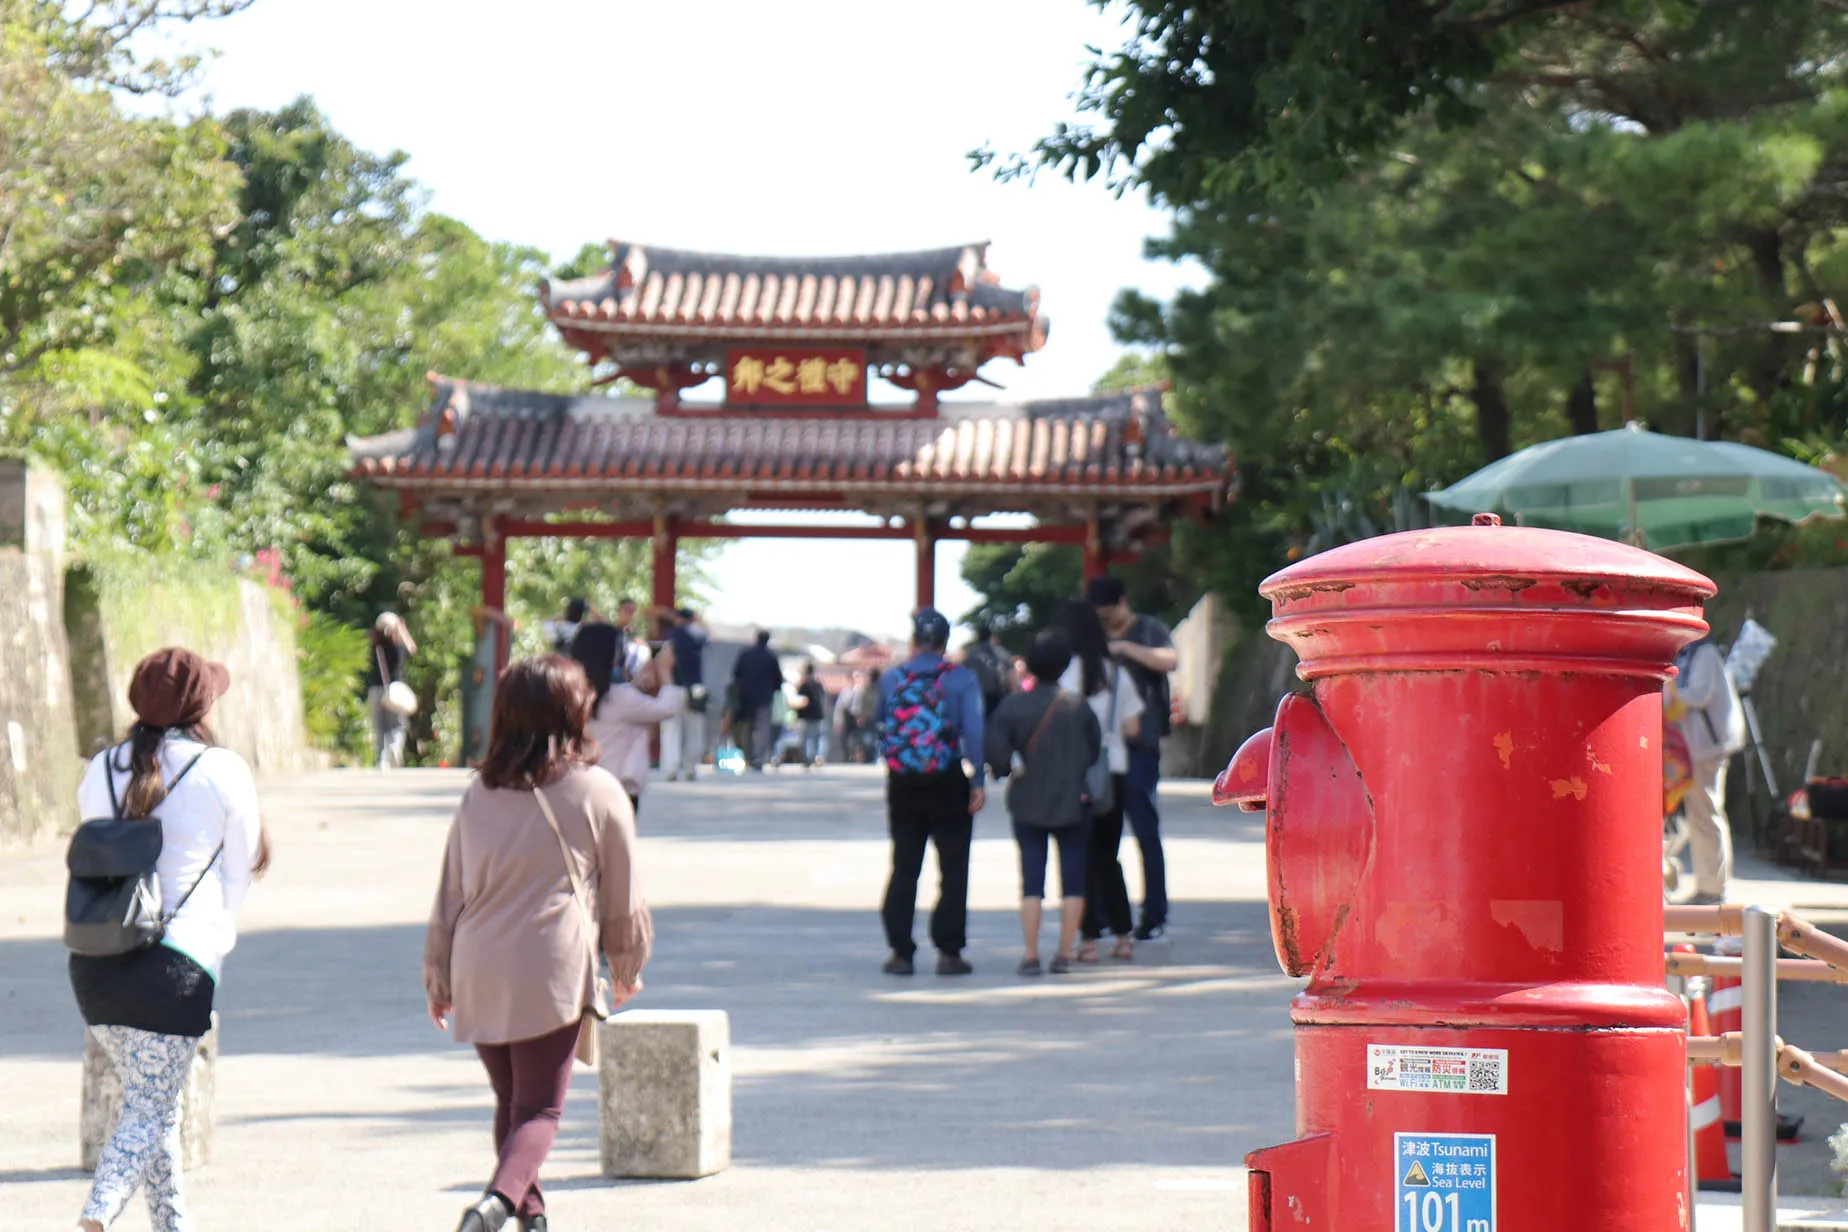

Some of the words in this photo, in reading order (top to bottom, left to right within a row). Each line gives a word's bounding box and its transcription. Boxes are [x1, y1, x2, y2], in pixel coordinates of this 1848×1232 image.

[1402, 1140, 1430, 1157] 津波
[1431, 1142, 1488, 1158] Tsunami
[1432, 1162, 1486, 1176] 海抜表示
[1432, 1176, 1453, 1188] Sea
[1455, 1177, 1486, 1189] Level
[1404, 1191, 1460, 1232] 101
[1466, 1219, 1489, 1232] m
